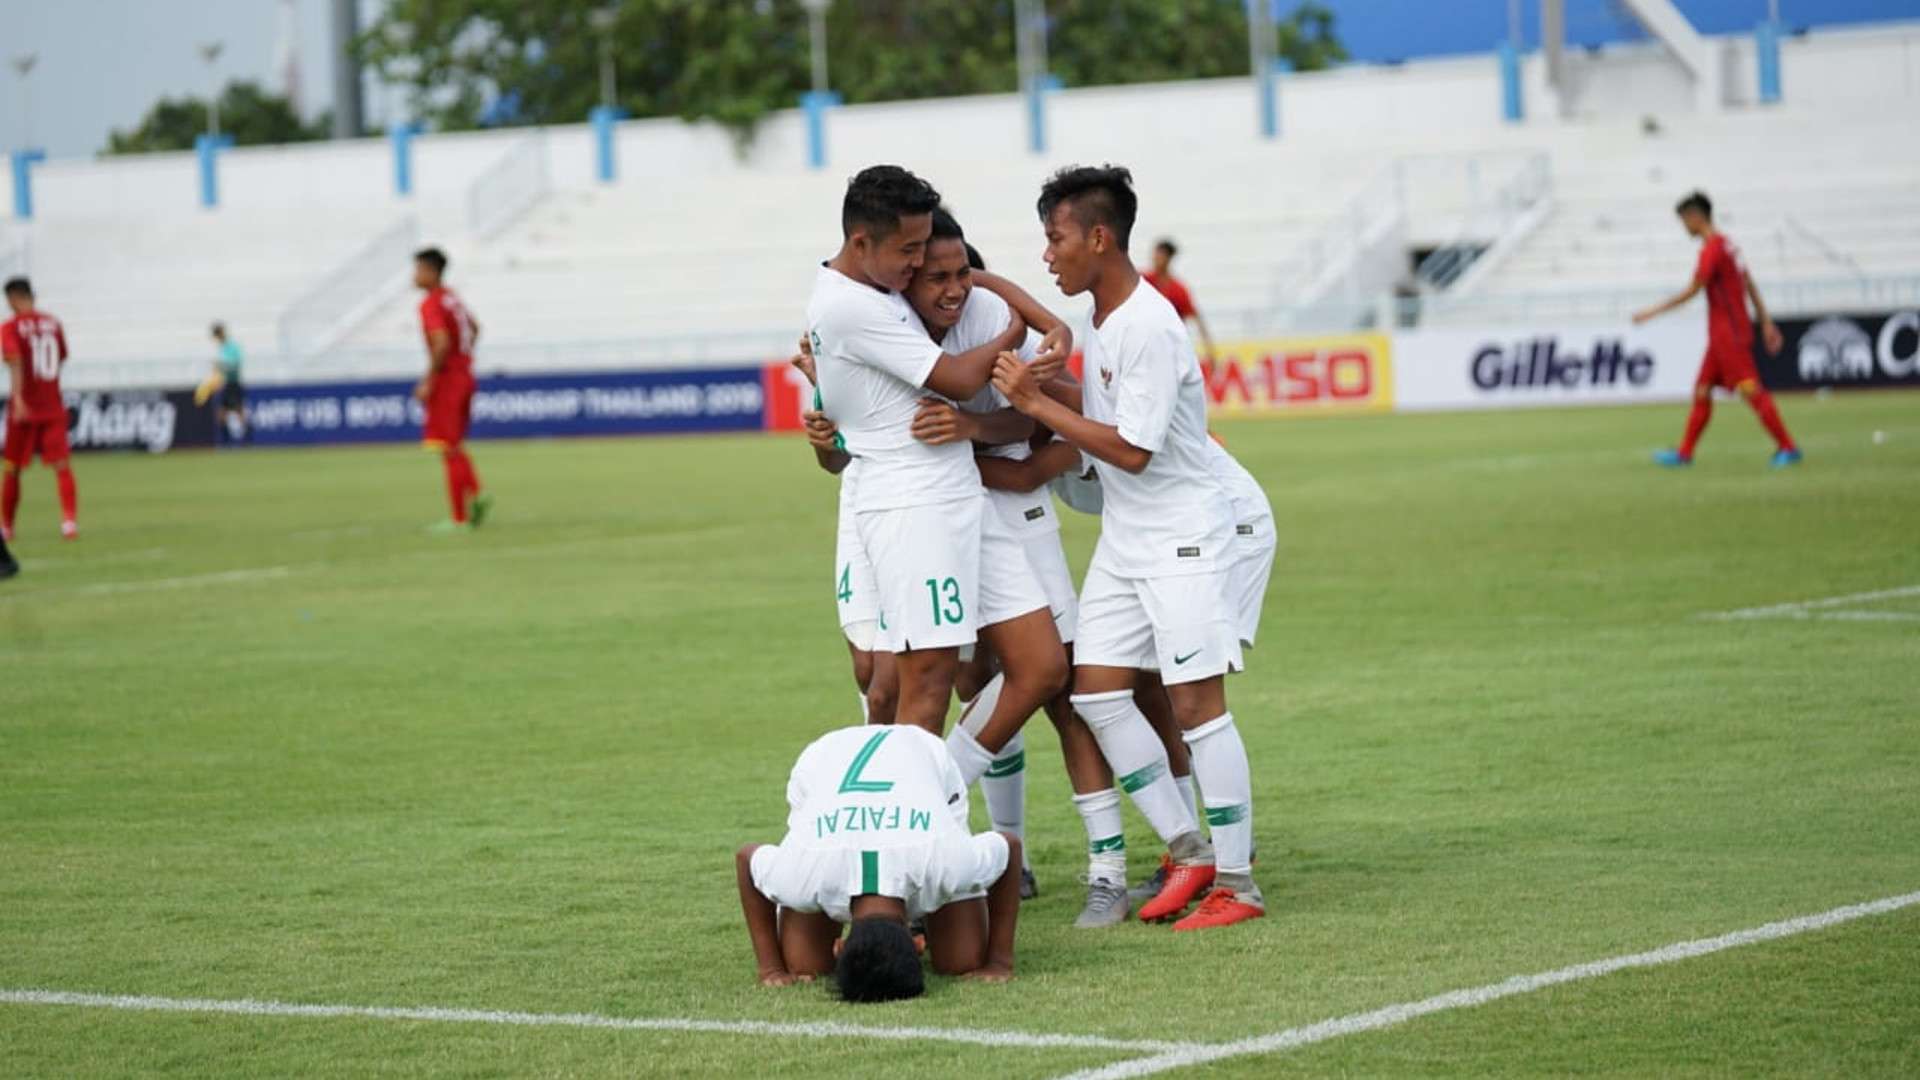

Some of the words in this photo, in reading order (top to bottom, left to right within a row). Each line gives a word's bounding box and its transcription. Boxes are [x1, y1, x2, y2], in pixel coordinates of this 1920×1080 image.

[31, 332, 60, 381] 10
[1472, 338, 1654, 390] Gillette
[345, 394, 405, 427] BOYS
[583, 384, 701, 419] THAILAND
[926, 577, 964, 626] 13
[838, 729, 895, 794] 7
[909, 808, 931, 832] M
